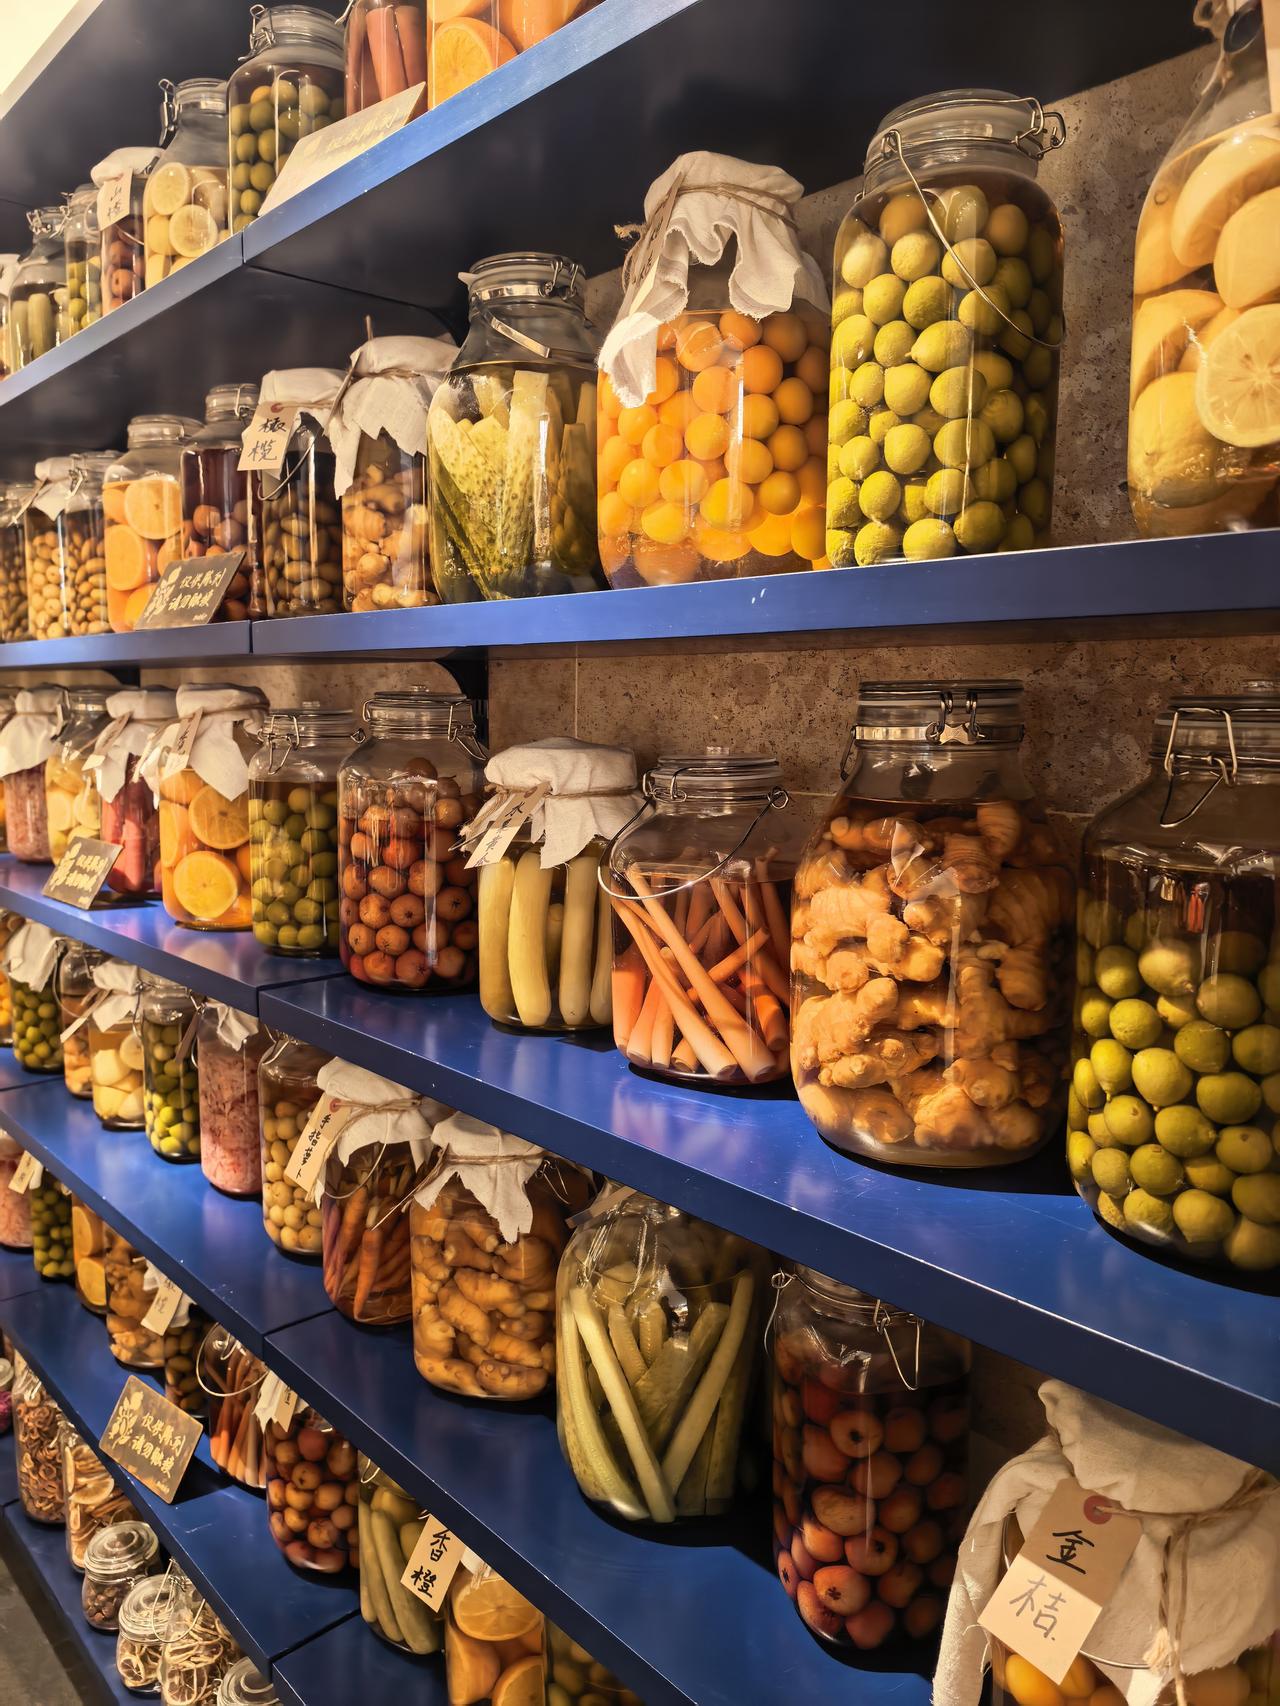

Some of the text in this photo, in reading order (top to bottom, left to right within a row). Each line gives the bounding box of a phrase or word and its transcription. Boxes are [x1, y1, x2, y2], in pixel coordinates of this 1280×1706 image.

[248, 416, 287, 463] 橄榄
[131, 1434, 176, 1479] 请勿触摸
[141, 1412, 186, 1458] 仅供陈列
[410, 1529, 451, 1598] 香橙
[1009, 1530, 1095, 1641] 金桔
